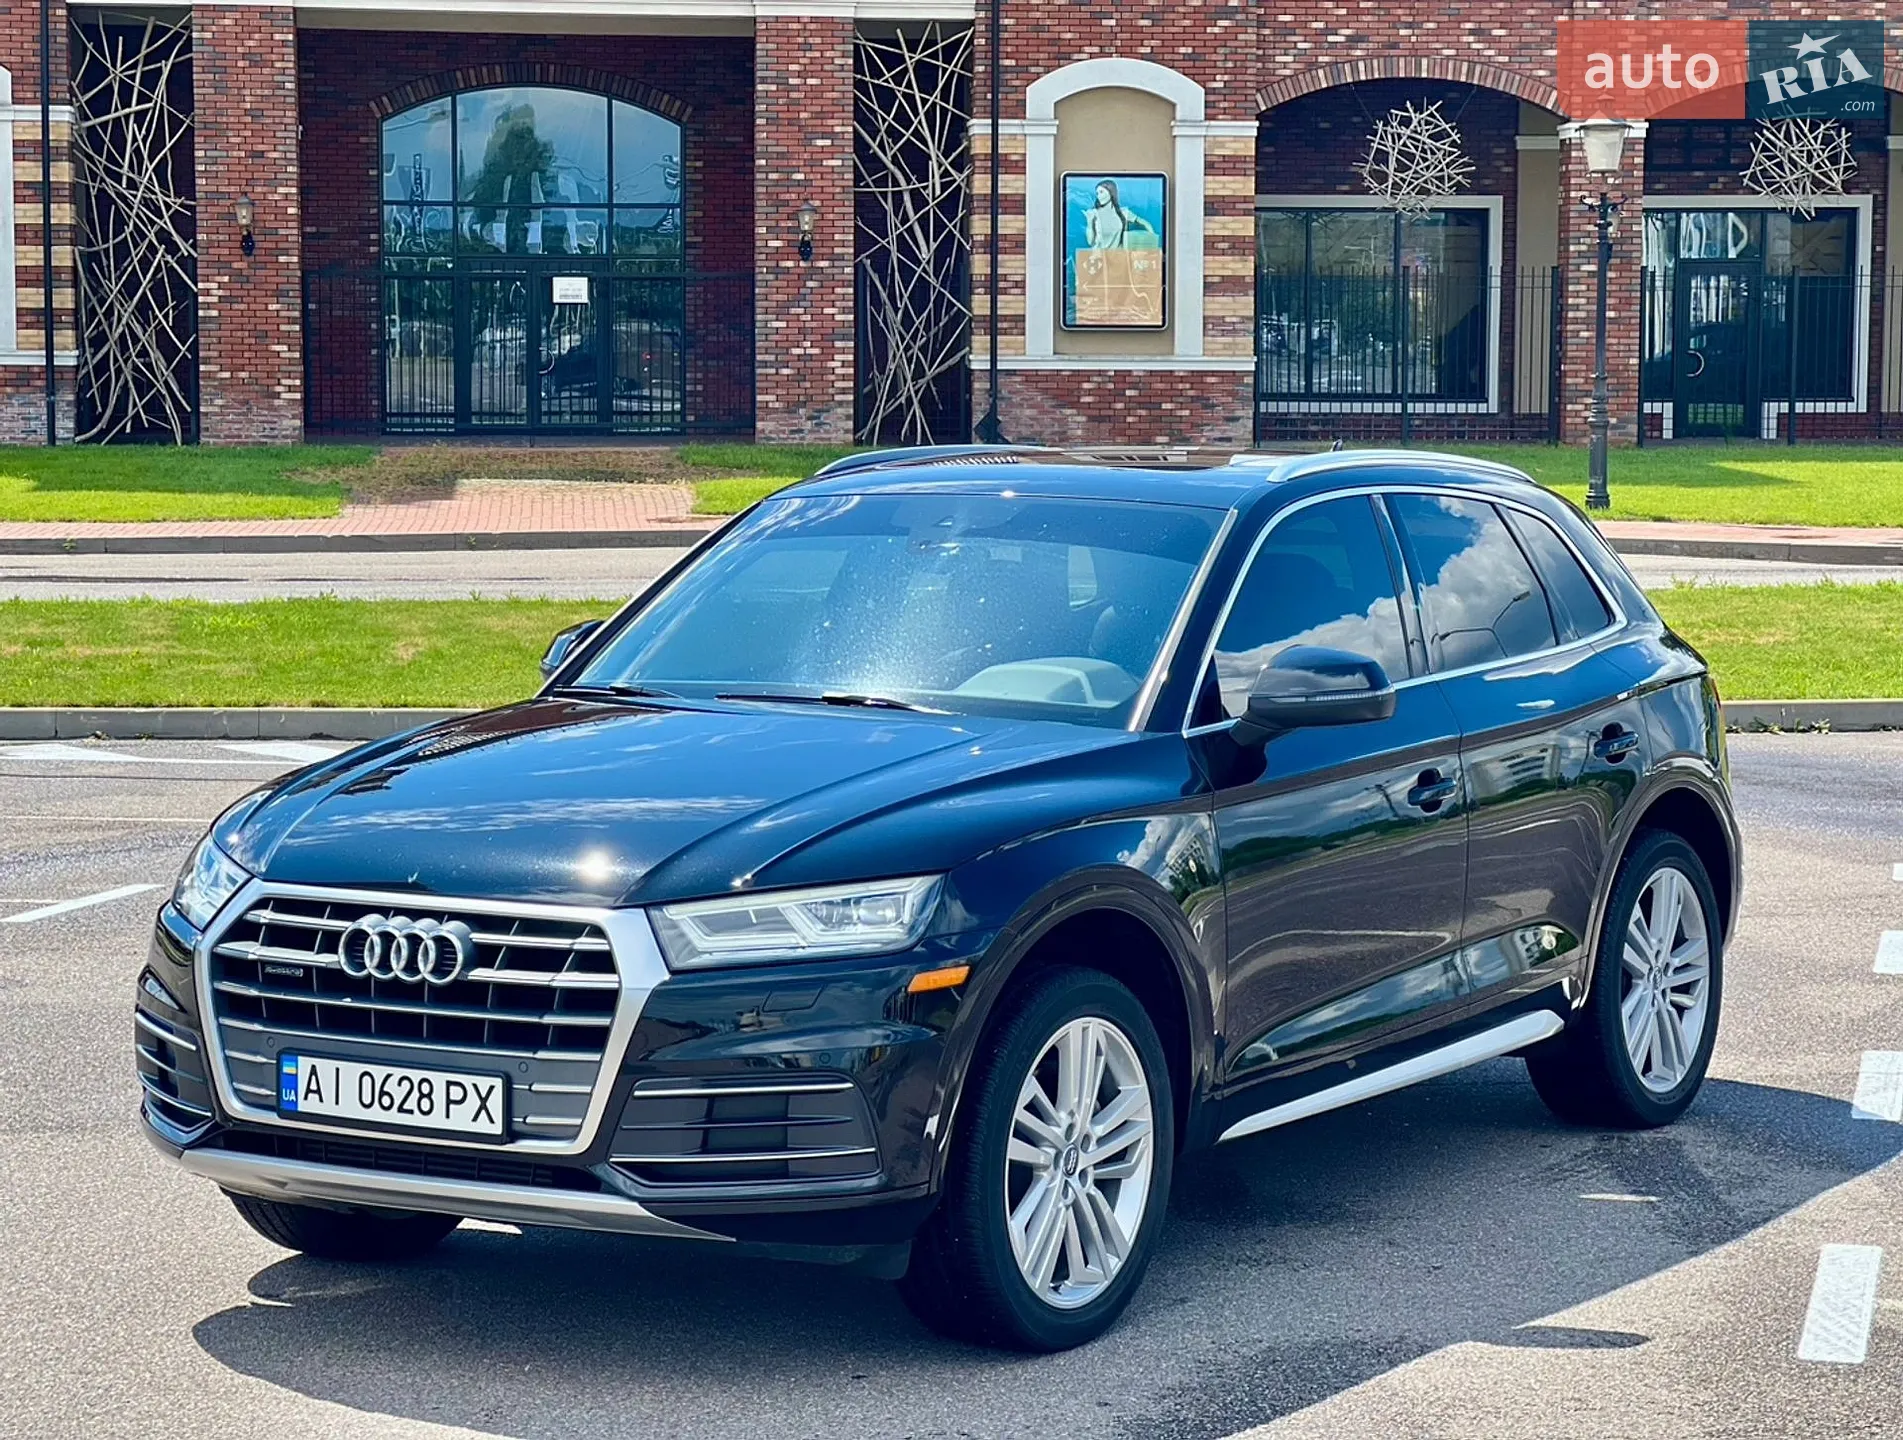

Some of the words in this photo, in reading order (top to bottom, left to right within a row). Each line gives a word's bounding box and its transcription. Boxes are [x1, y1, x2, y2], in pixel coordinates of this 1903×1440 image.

[282, 1088, 296, 1102] UA
[303, 1064, 340, 1106] AI
[358, 1070, 434, 1117] 0628
[445, 1080, 496, 1125] PX
